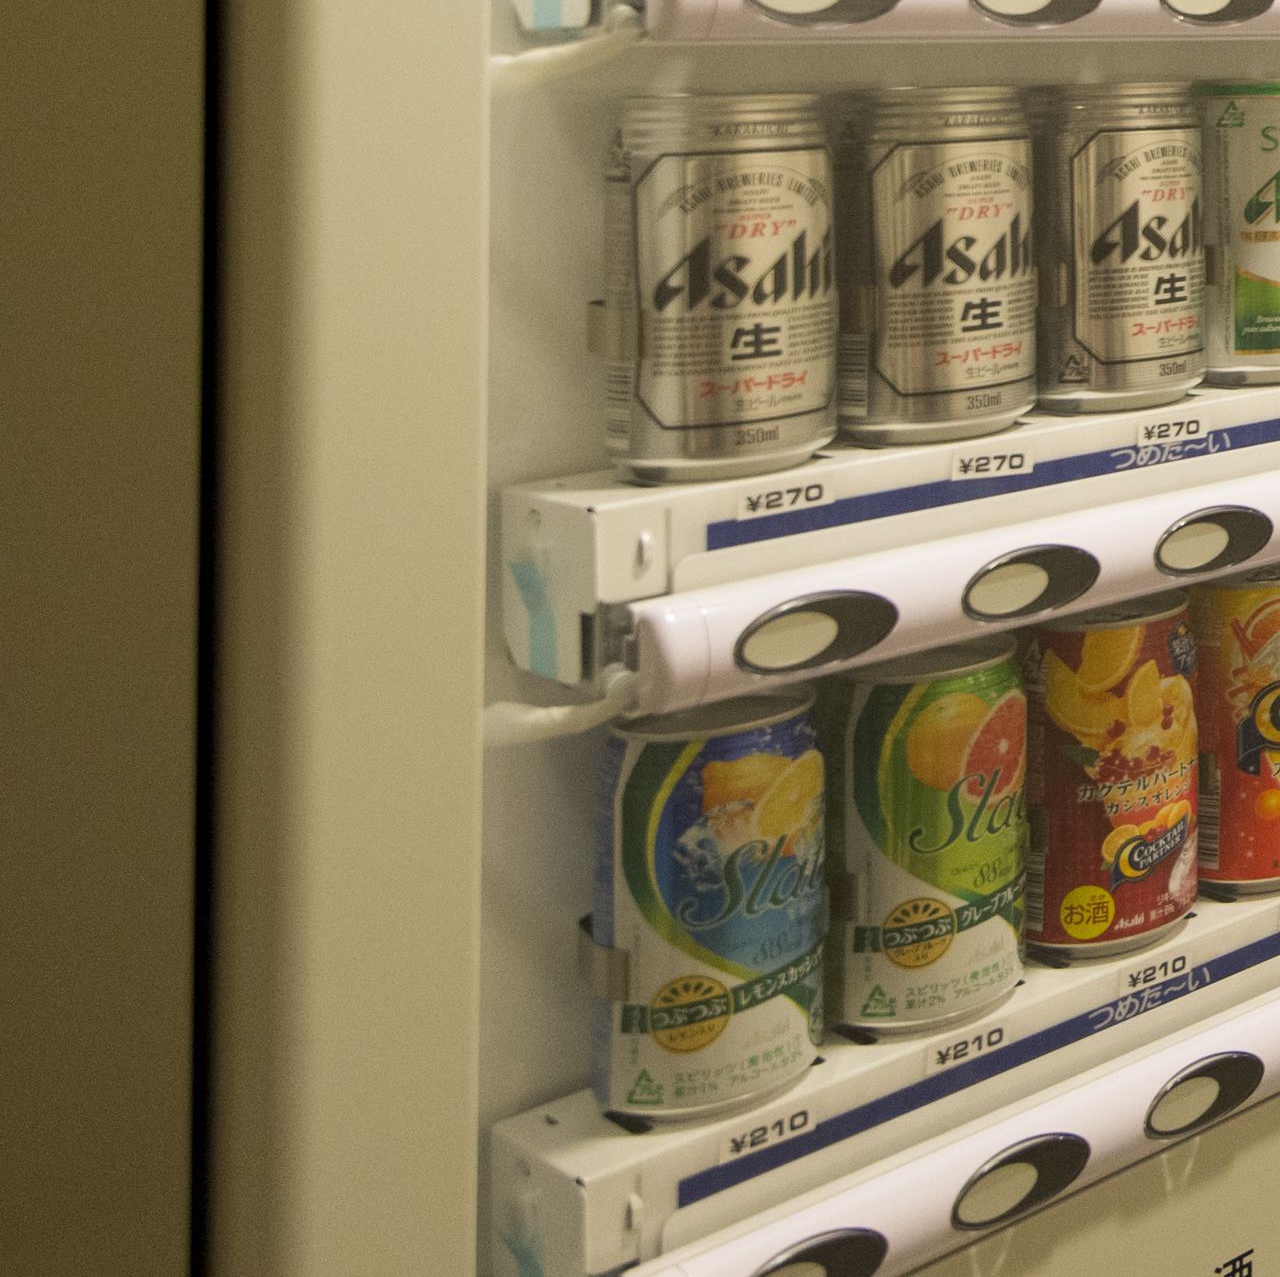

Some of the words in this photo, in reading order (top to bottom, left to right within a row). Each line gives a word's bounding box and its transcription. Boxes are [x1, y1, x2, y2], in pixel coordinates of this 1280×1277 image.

[1091, 195, 1205, 264] Asah
[890, 212, 1033, 288] Asah
[653, 223, 832, 313] Asahi
[1154, 272, 1189, 305] 生
[961, 298, 1003, 333] 生
[1131, 315, 1198, 337] スーパードラ
[730, 322, 783, 362] 生
[934, 340, 1023, 367] スーパードライ
[1159, 360, 1187, 377] 350ml
[700, 370, 809, 401] スーパードライ
[966, 393, 1001, 411] 350ml
[1143, 419, 1200, 441] ¥270
[959, 452, 1025, 474] ¥270
[746, 482, 824, 513] ¥270
[1063, 900, 1111, 926] お酒
[1127, 954, 1187, 988] ¥210
[935, 1027, 1005, 1066] ¥210
[728, 1109, 809, 1154] ¥210
